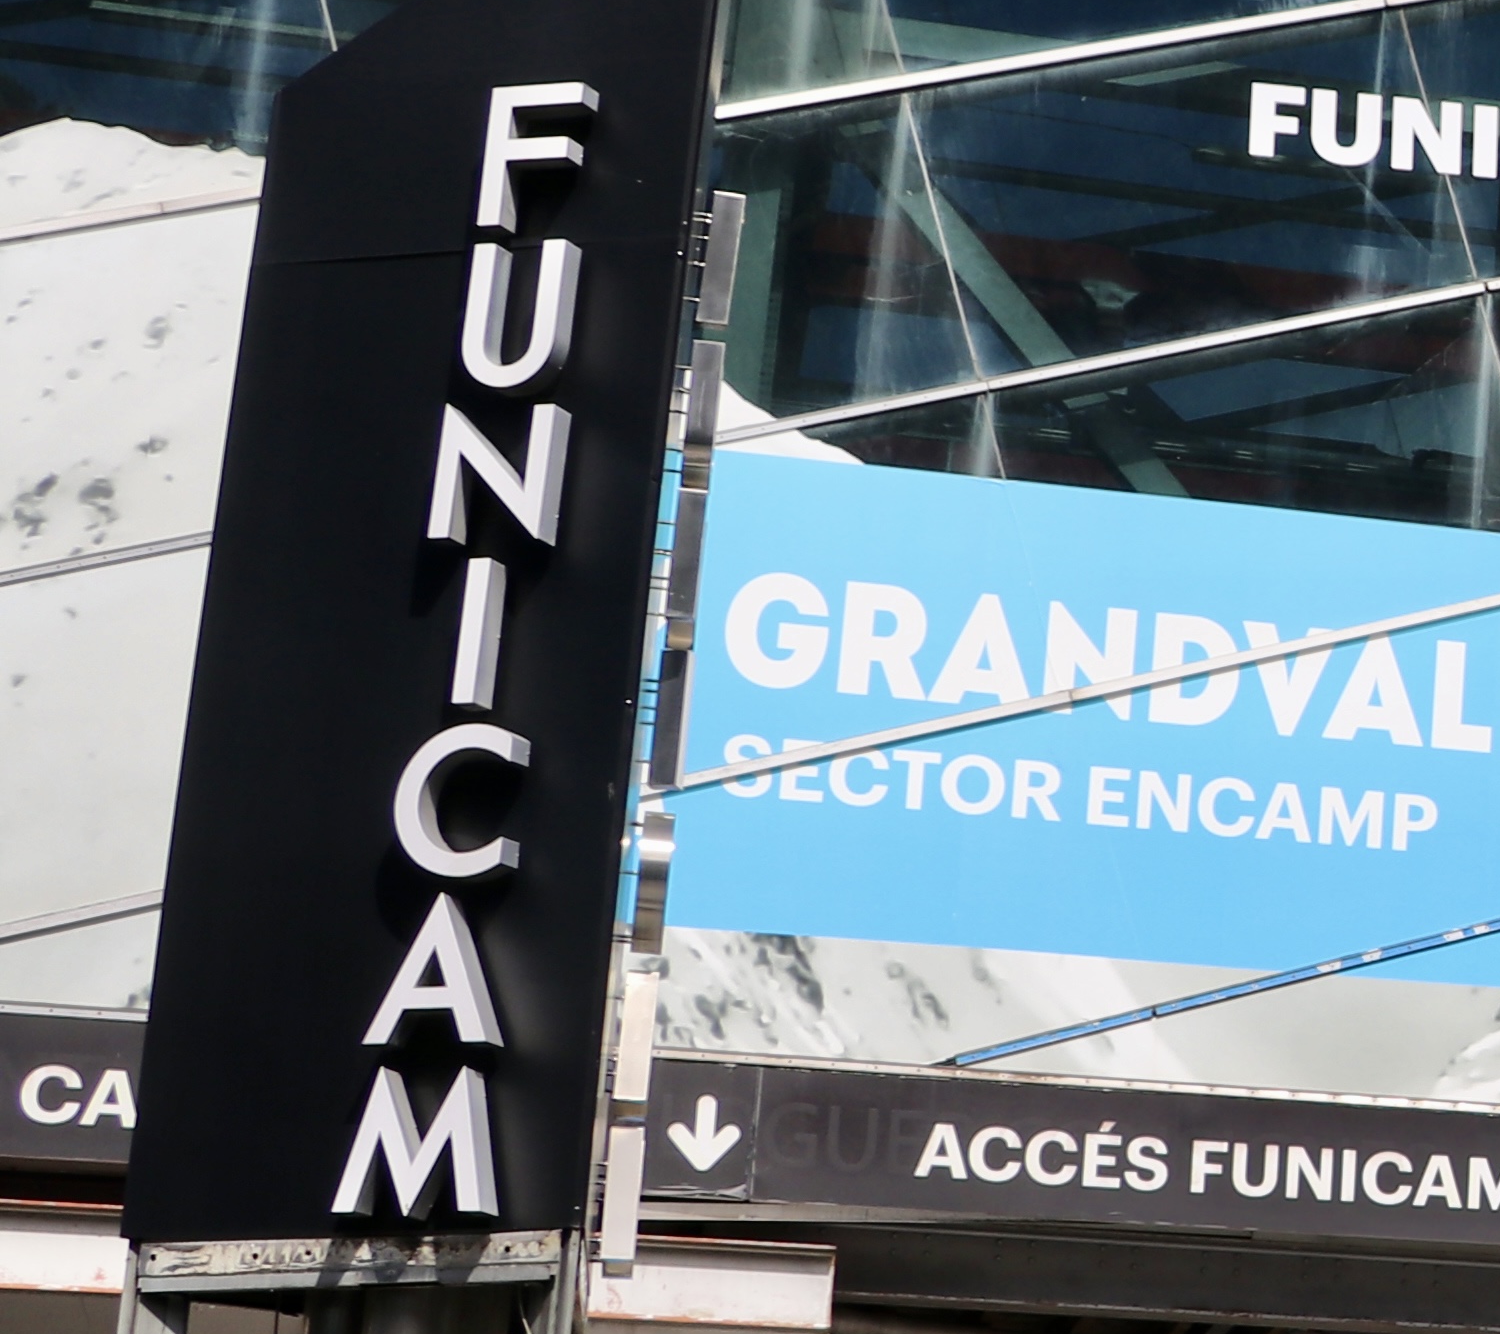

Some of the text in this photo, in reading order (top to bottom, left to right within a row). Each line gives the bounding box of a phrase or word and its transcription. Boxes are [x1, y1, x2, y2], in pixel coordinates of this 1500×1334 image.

[331, 83, 600, 1219] FUNICAM
[722, 734, 1438, 852] SECTOR ENCAMP
[915, 1121, 1169, 1191] ACCÉS
